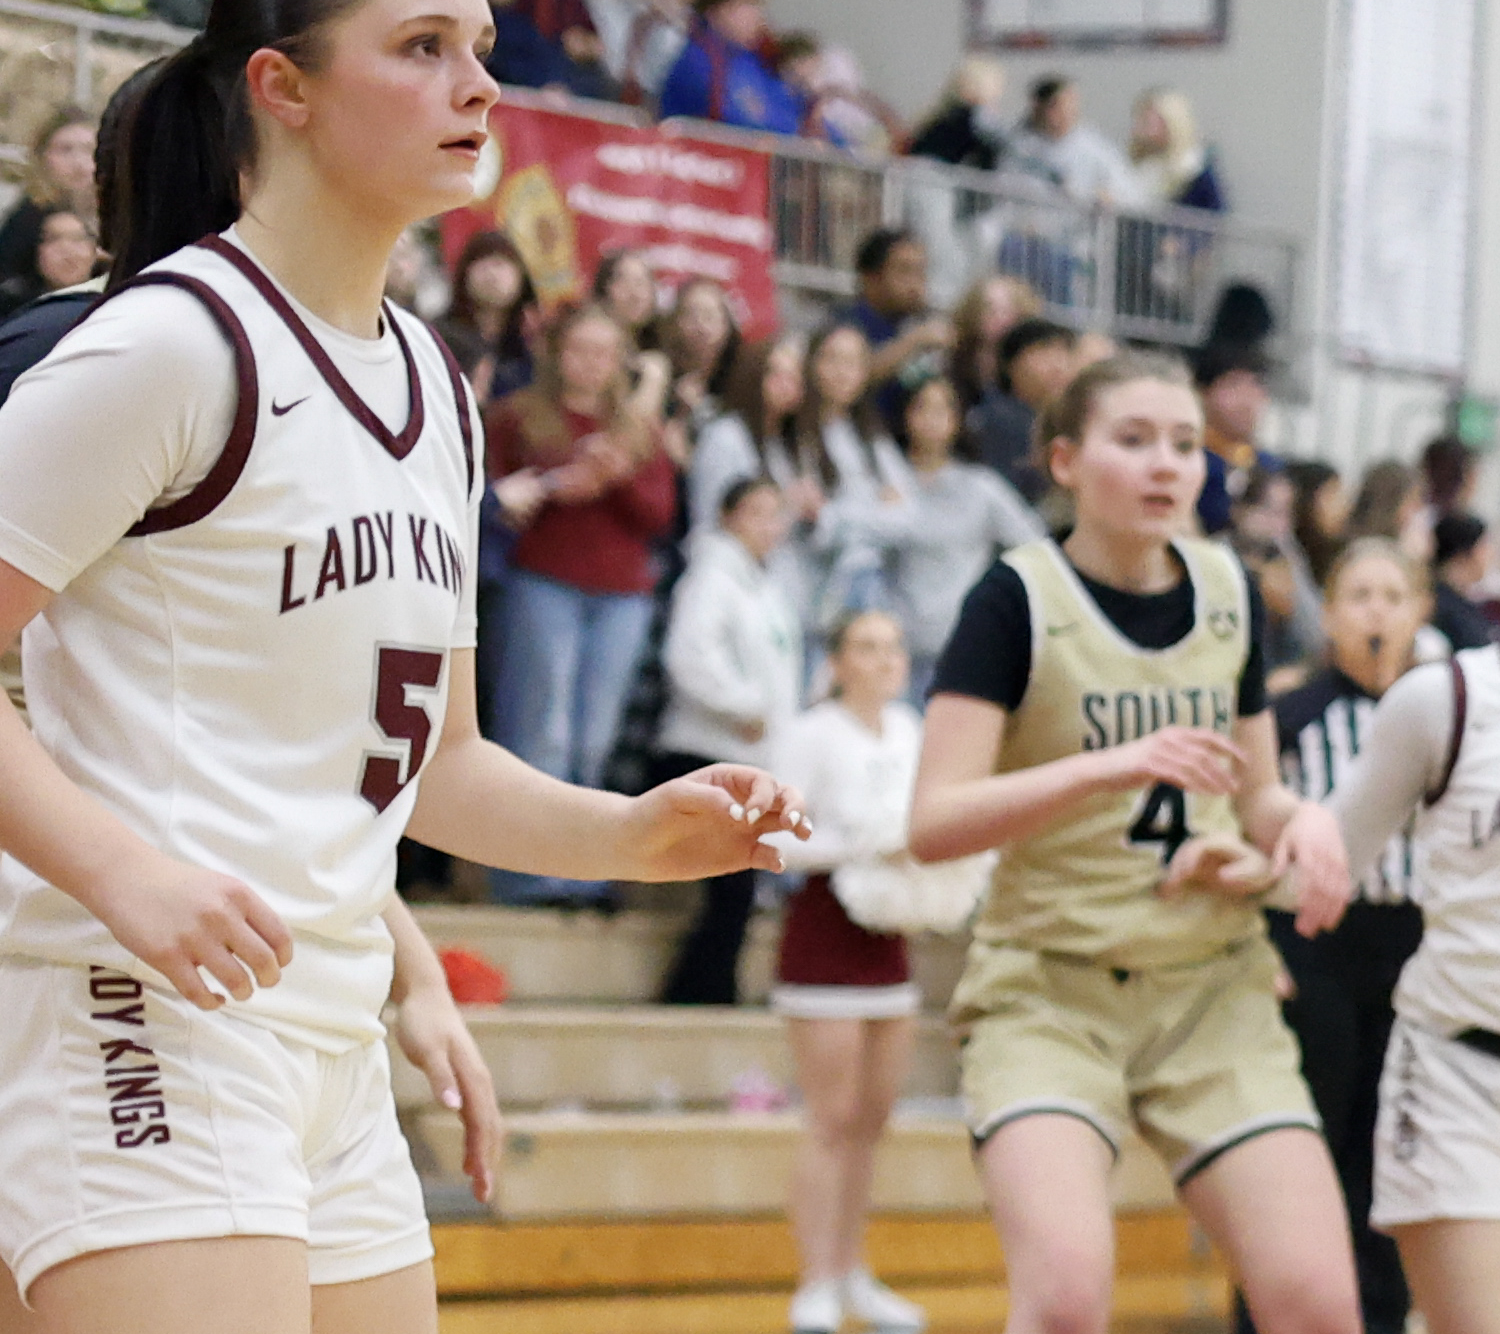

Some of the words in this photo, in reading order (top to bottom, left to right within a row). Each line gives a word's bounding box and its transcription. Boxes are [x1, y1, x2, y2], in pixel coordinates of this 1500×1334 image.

[279, 509, 395, 615] LADY
[355, 641, 447, 817] 5
[1128, 779, 1192, 868] 4
[89, 965, 145, 1027] DY
[100, 1038, 171, 1149] KINGS
